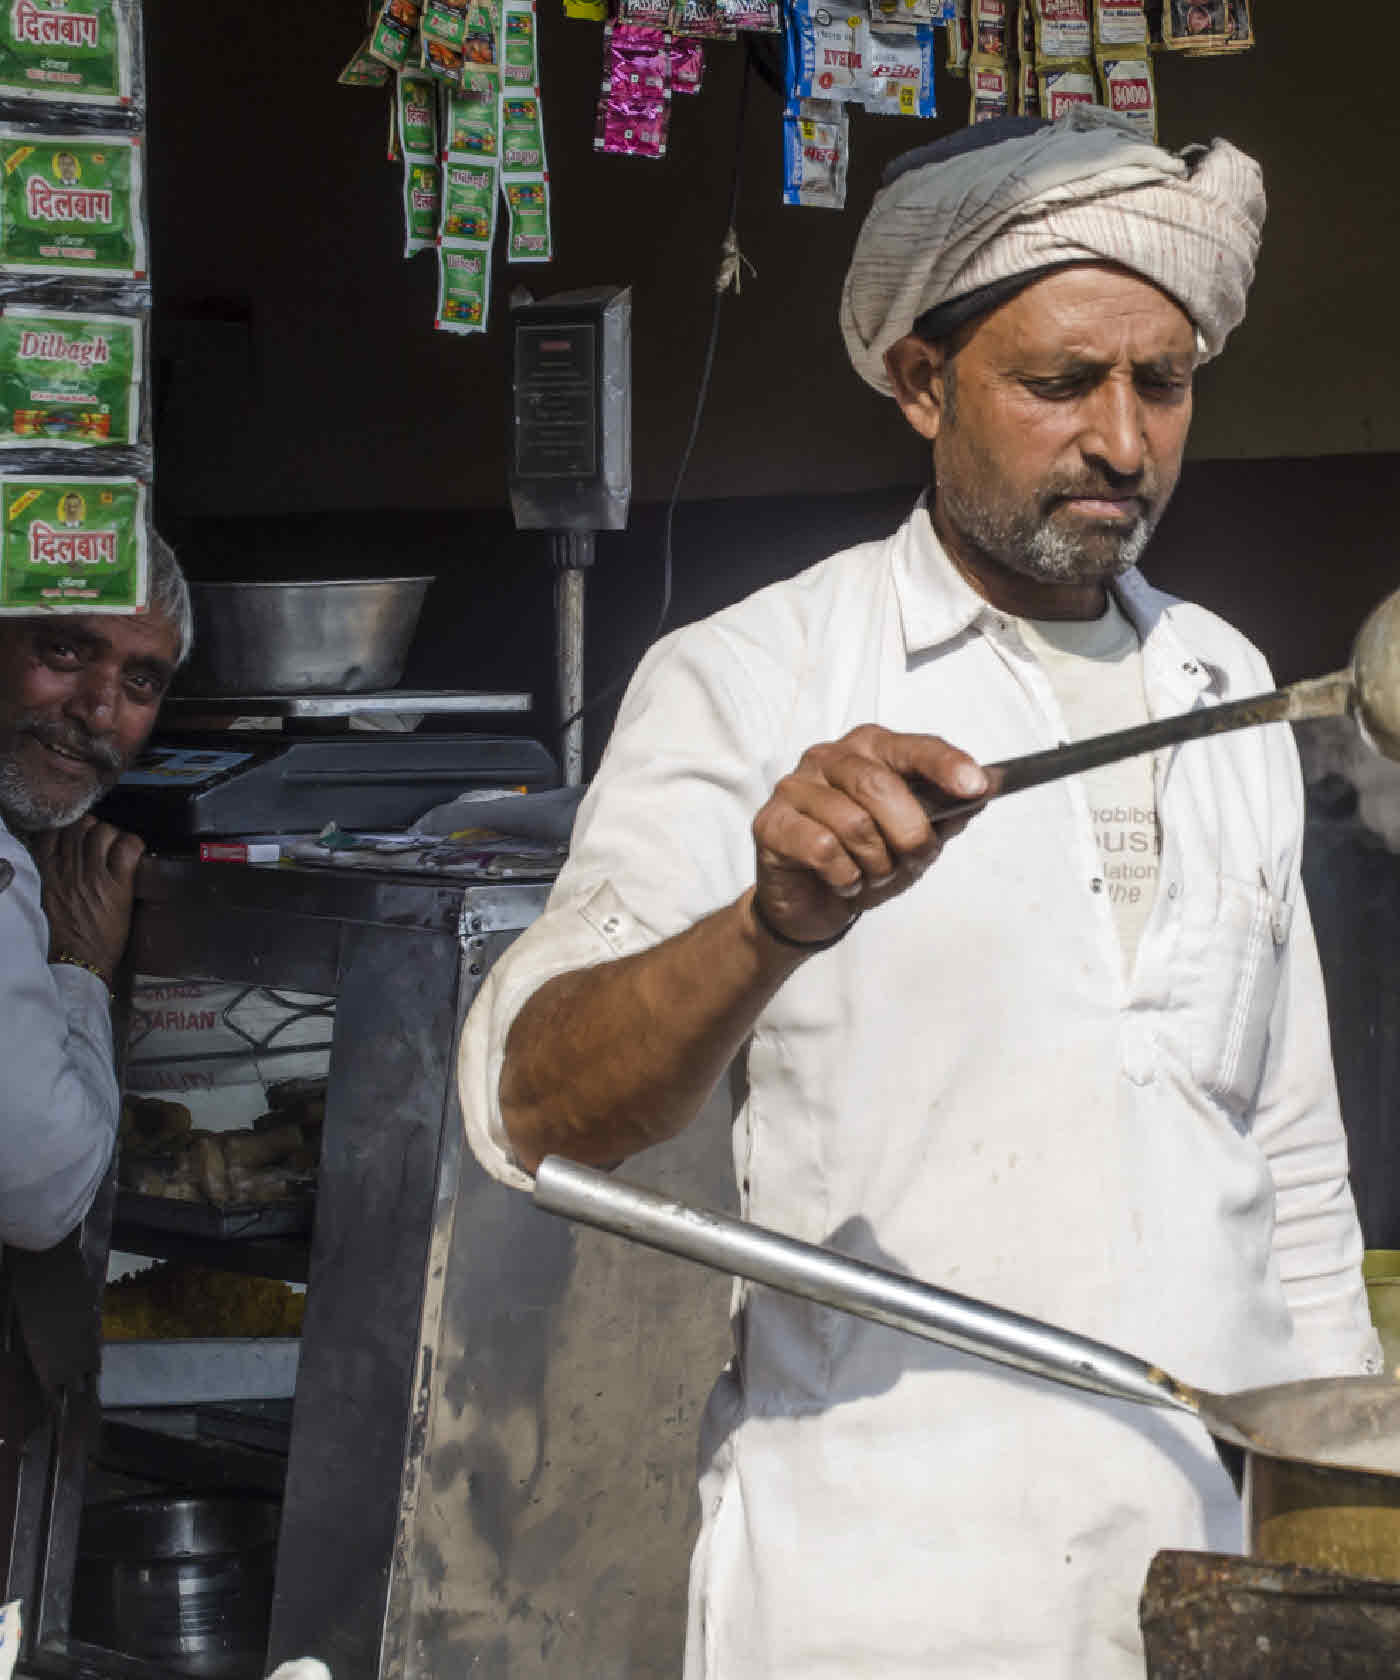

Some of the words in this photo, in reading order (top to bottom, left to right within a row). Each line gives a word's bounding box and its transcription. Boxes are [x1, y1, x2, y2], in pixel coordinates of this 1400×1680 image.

[14, 0, 97, 46] दिलबाग
[27, 176, 112, 222] दिलबाग
[19, 331, 108, 367] Dilbagh
[30, 520, 117, 563] दिलबाग
